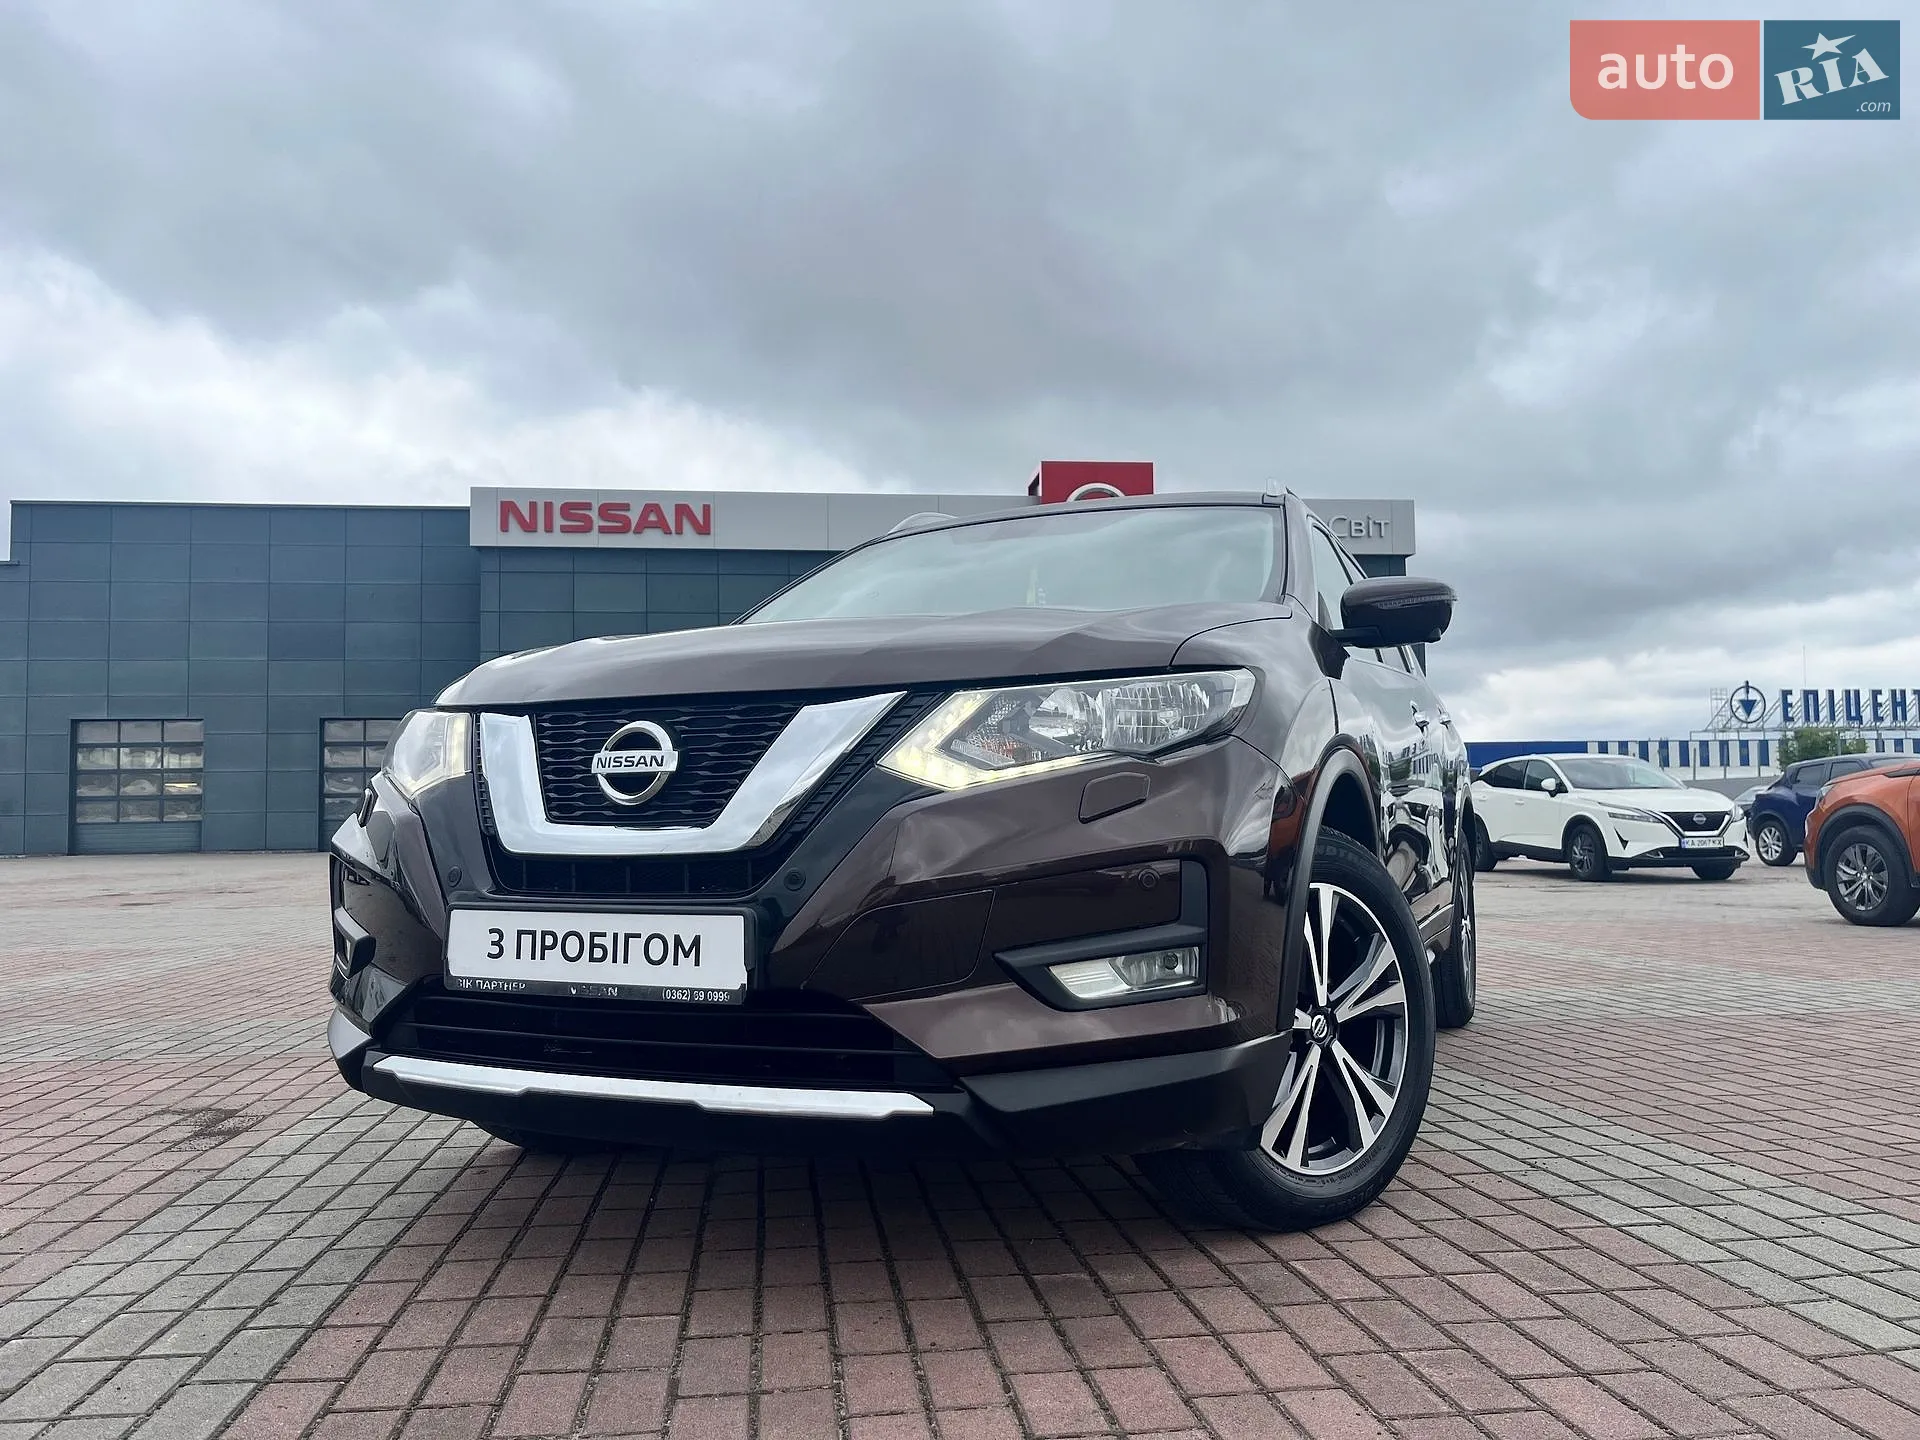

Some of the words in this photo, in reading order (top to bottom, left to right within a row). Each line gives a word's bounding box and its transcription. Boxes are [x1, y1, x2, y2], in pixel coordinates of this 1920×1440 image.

[499, 500, 712, 536] NISSAN
[596, 755, 664, 769] NISSAN
[486, 927, 505, 960] З
[515, 928, 702, 967] ПРОБІГОМ
[662, 988, 691, 1001] (0362)
